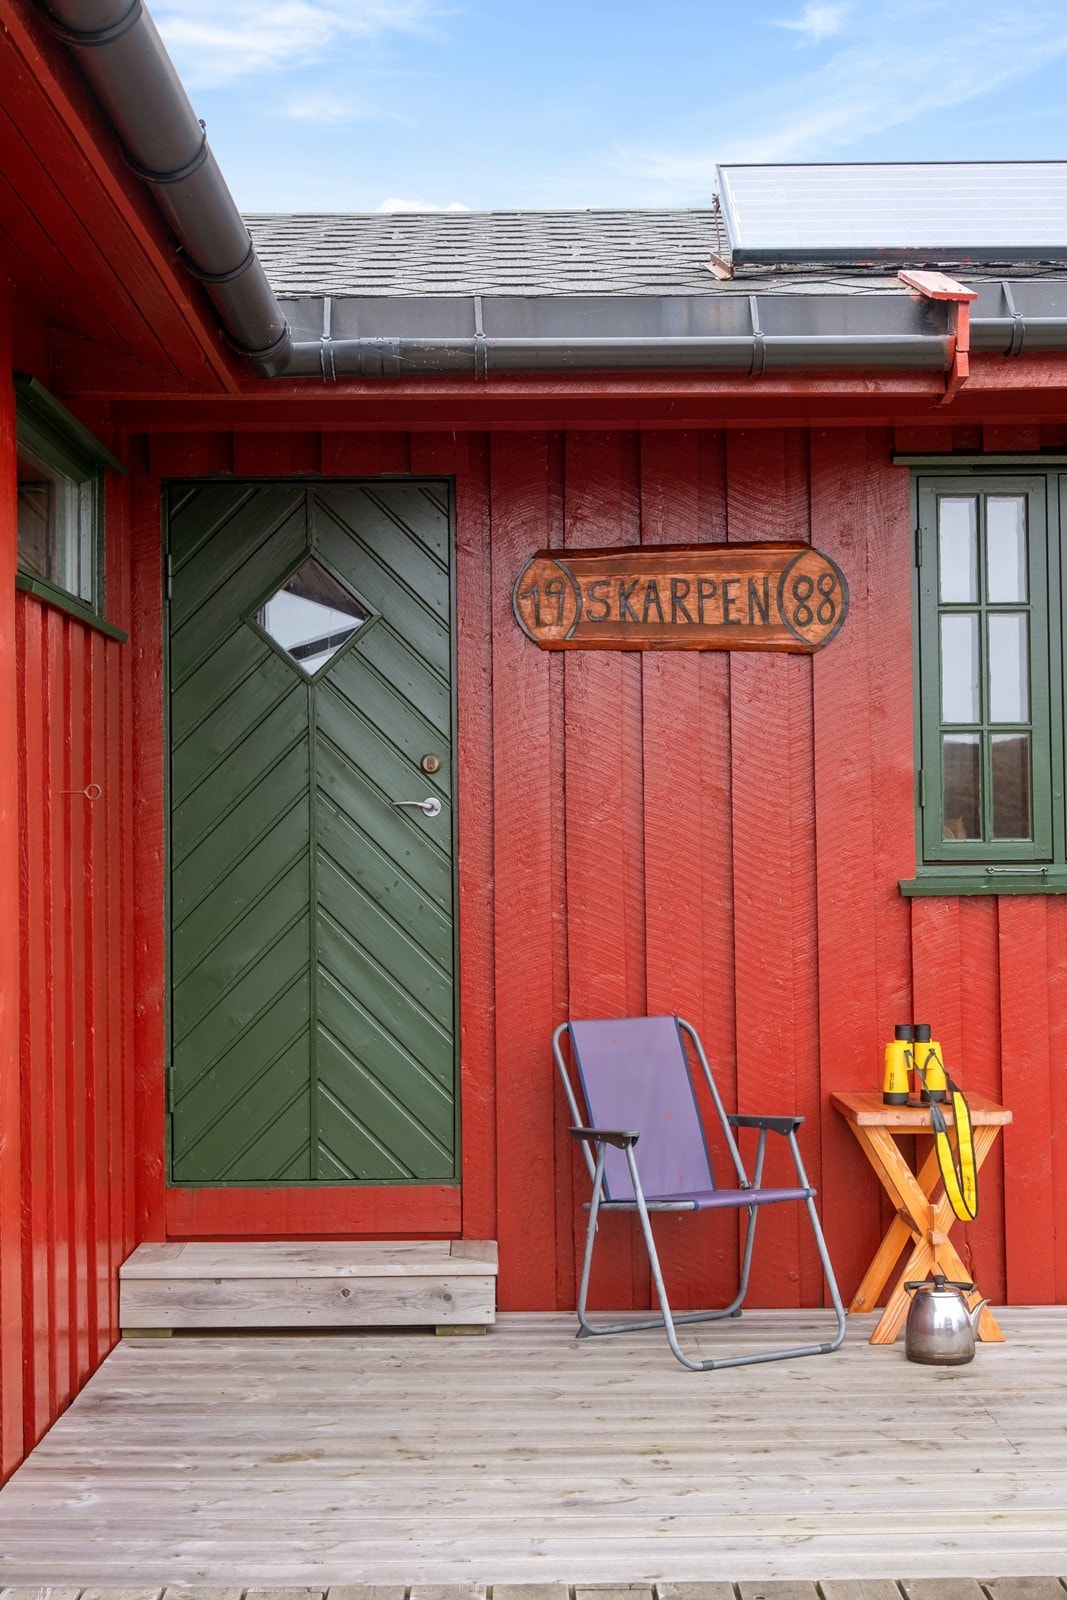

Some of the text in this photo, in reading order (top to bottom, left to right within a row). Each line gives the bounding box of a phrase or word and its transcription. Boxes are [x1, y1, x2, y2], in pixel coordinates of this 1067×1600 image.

[521, 572, 837, 627] 19 SKARPEN 88
